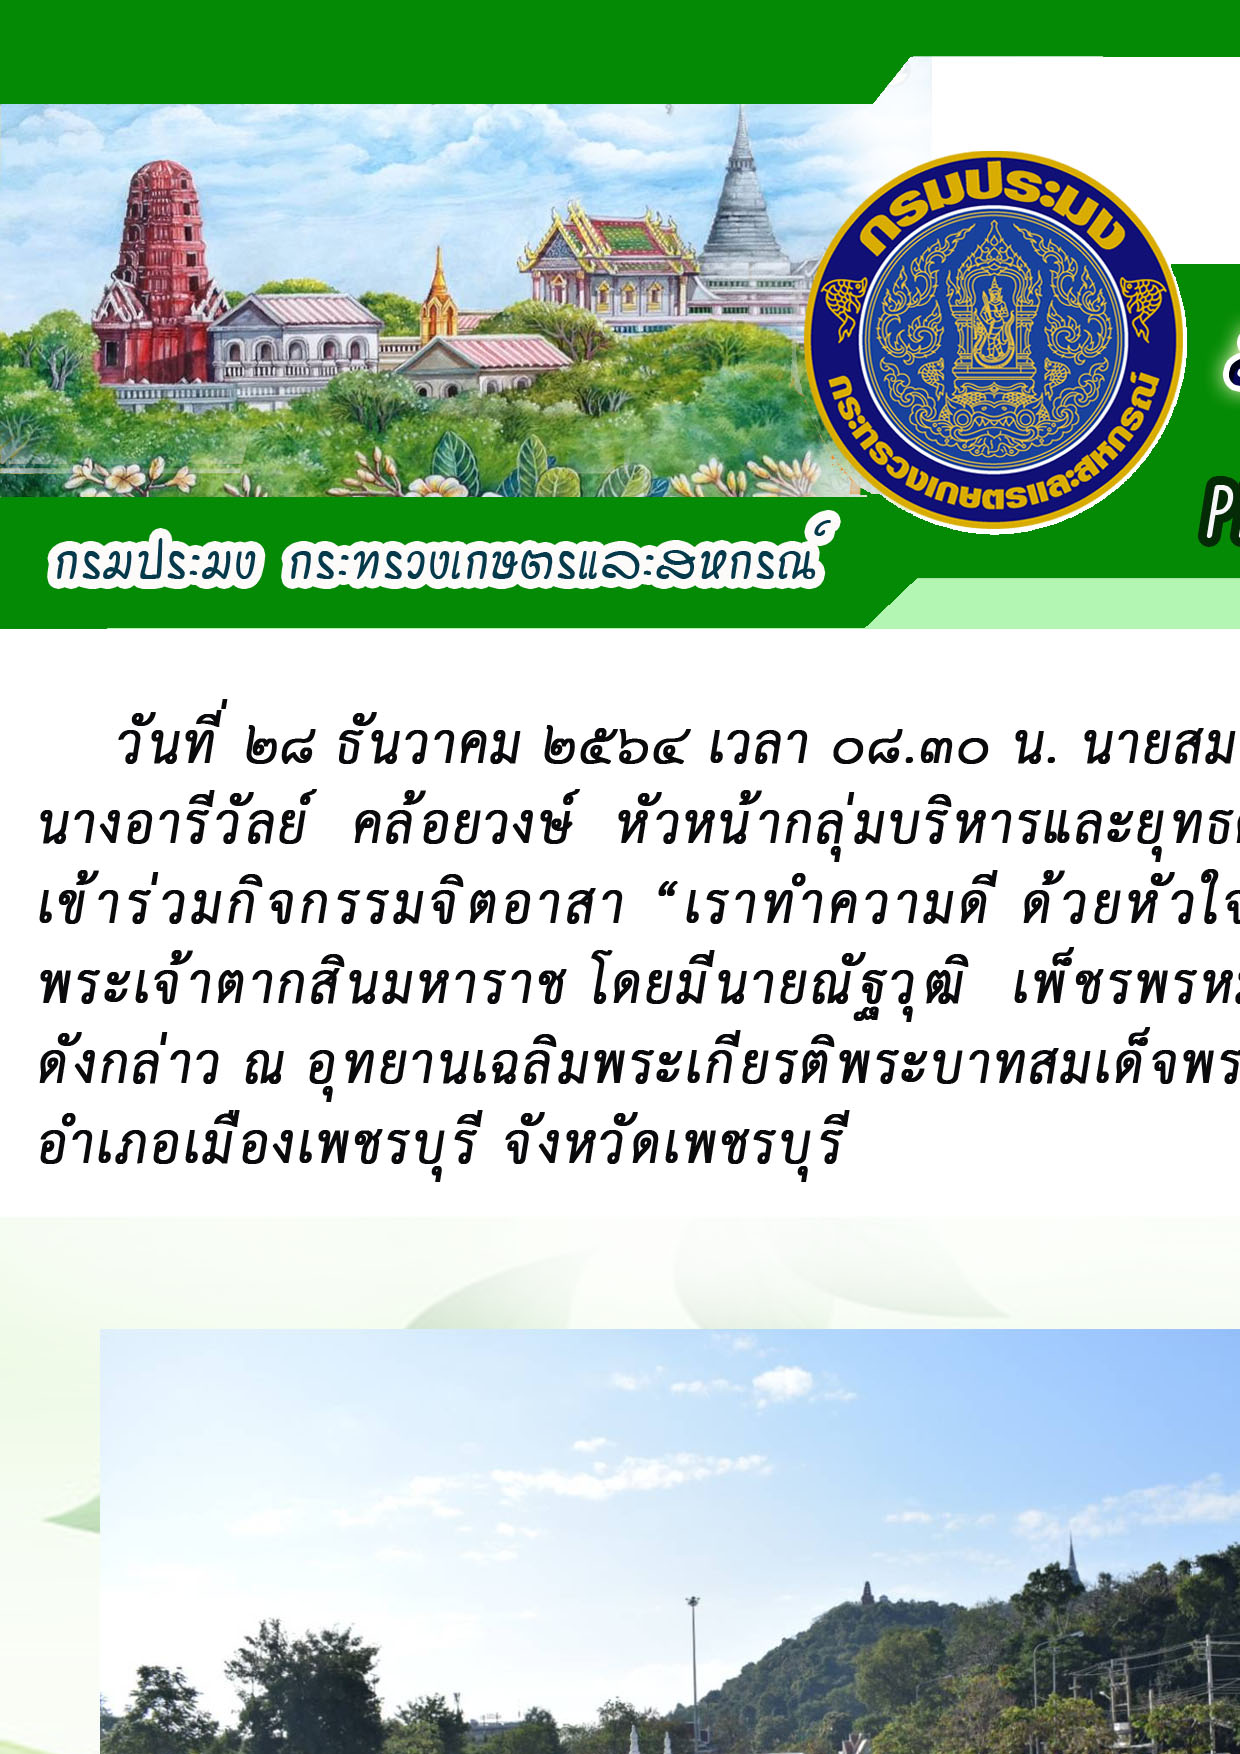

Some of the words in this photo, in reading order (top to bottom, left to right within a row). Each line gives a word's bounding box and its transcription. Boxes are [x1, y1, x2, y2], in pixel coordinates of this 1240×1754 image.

[859, 160, 1126, 257] กรมประมง
[828, 371, 1161, 510] กระทรวงเกษตรและสหกรณ์
[56, 537, 257, 580] กรมประมง
[290, 519, 832, 581] กระทรวงเกษตรและสหกรณ์
[119, 699, 227, 764] วันที่
[247, 725, 315, 764] ๒๘
[339, 712, 520, 764] ธันวาคม
[545, 725, 691, 764] ๒๕๖๔
[711, 730, 807, 764] เวลา
[834, 729, 988, 764] ๐๘.๓๐
[1016, 730, 1055, 764] น.
[41, 789, 317, 844] นางอารีวัลย์
[355, 789, 580, 844] คล้อยวงษ์
[40, 870, 622, 924] เข้าร่วมกิจกรรมจิตอาสา
[41, 950, 566, 1004] พระเจ้าตากสินมหาราช
[592, 950, 968, 1022] โดยมีนายณัฐวุฒิ
[40, 1032, 218, 1084] ดังกล่าว
[246, 1050, 284, 1084] ณ
[41, 1110, 482, 1182] อำเภอเมืองเพชรบุรี
[506, 1110, 849, 1182] จังหวัดเพชรบุรี
